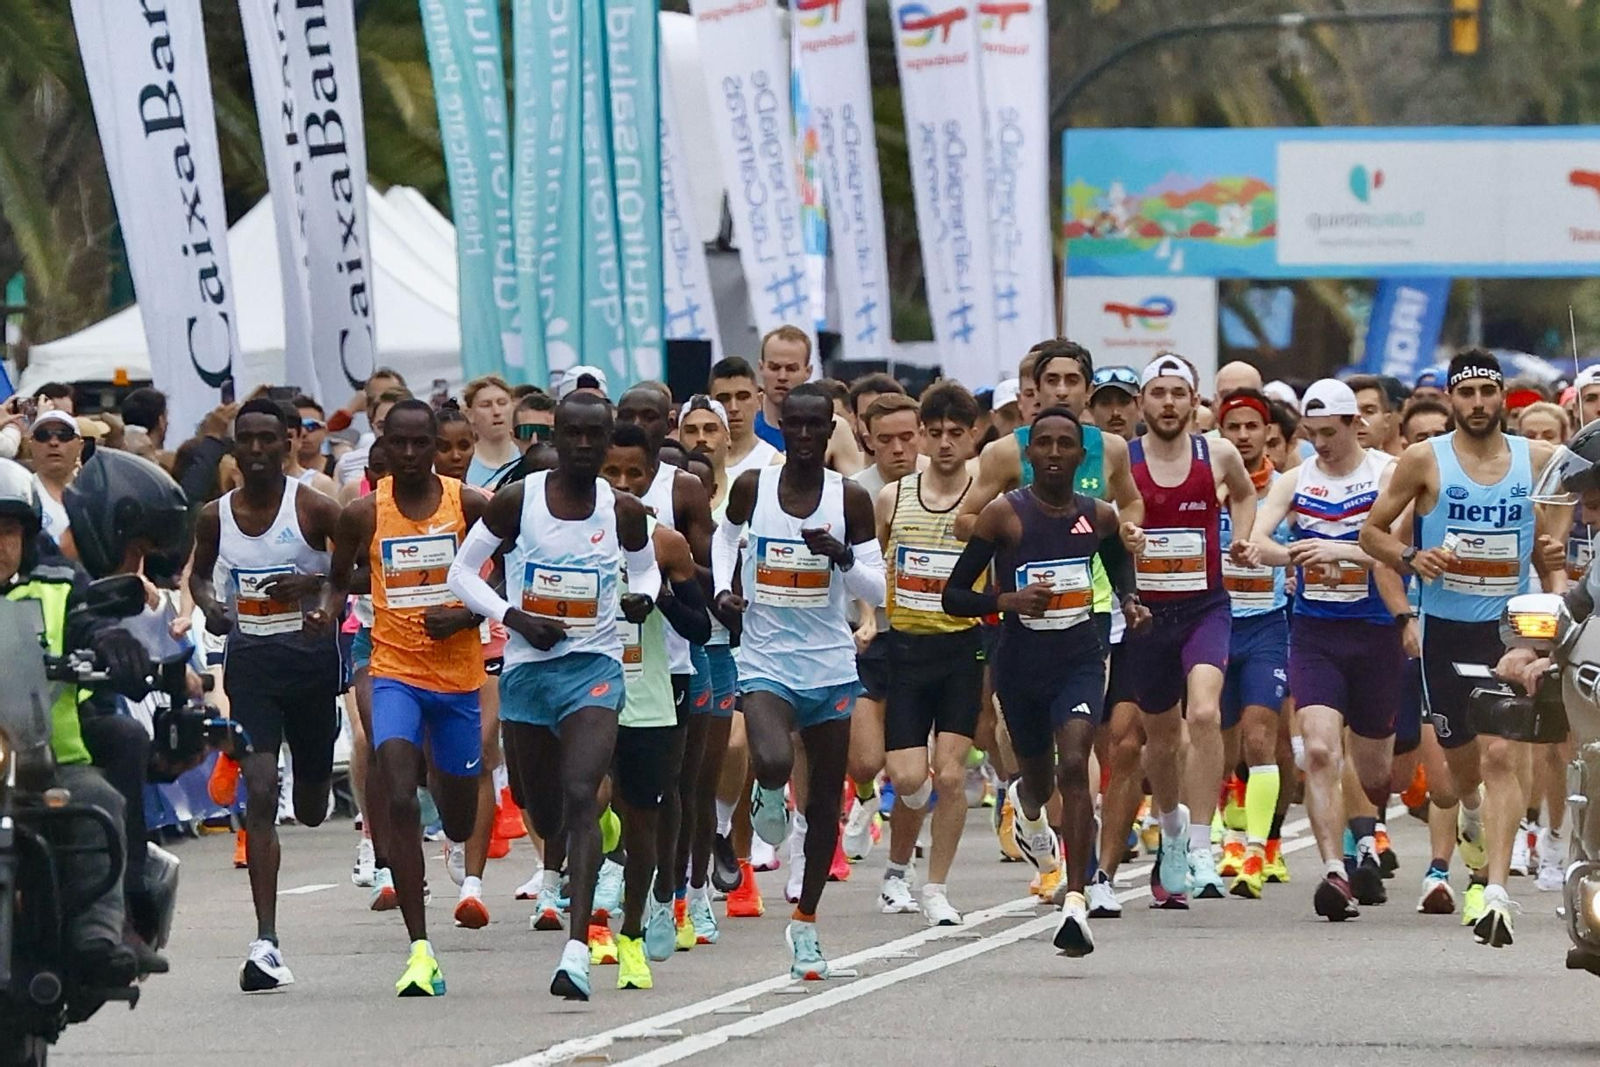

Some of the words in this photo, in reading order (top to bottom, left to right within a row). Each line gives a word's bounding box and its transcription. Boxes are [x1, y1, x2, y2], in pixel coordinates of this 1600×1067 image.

[296, 0, 376, 391] CaixaBan
[1447, 499, 1523, 528] nerja
[419, 570, 430, 586] 2
[790, 572, 799, 588] 1
[556, 600, 568, 617] 9
